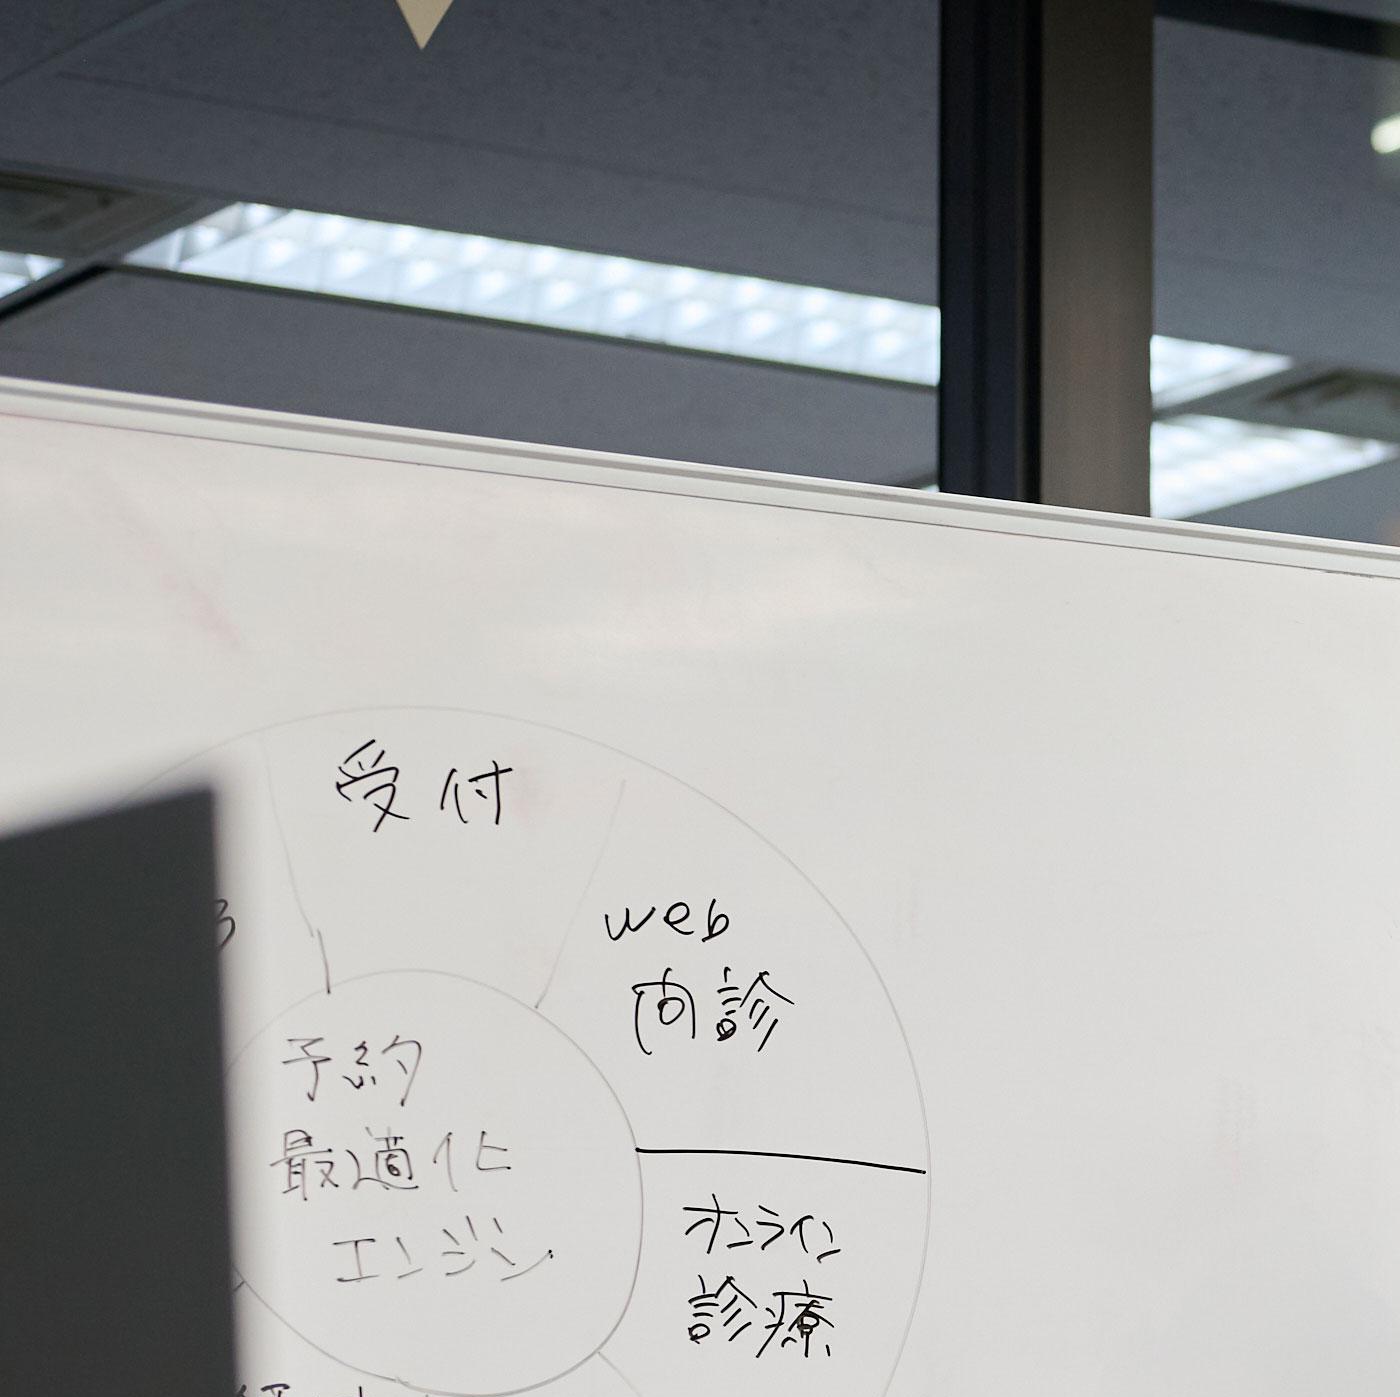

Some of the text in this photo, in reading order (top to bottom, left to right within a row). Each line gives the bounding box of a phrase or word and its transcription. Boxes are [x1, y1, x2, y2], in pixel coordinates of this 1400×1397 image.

[334, 738, 515, 834] 受付
[281, 1034, 424, 1108] 予約
[269, 1126, 513, 1203] 最適化
[331, 1214, 556, 1285] エンジン
[681, 1192, 843, 1266] オンライン
[685, 1273, 837, 1360] 診療
